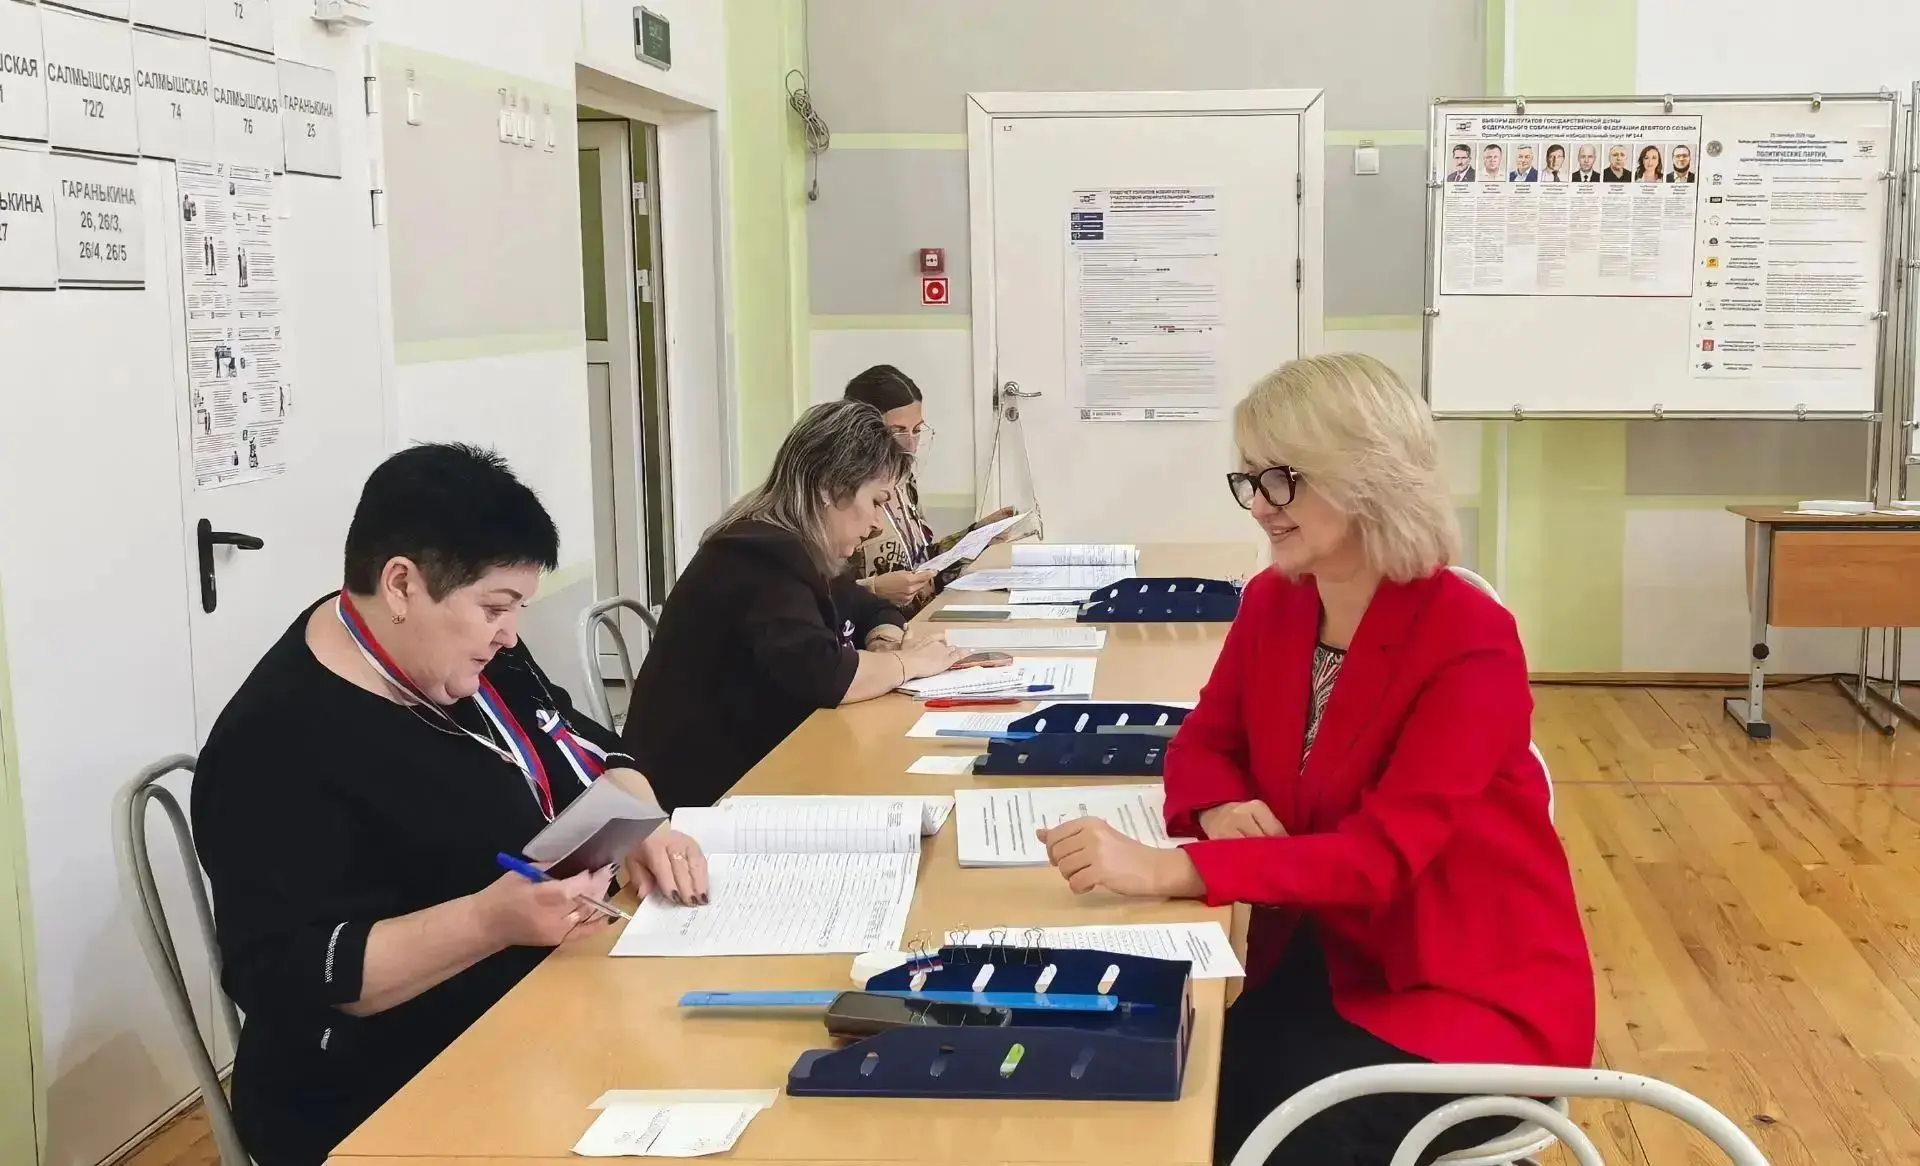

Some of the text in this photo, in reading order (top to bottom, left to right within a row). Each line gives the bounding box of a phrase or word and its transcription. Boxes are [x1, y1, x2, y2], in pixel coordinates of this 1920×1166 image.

[233, 2, 244, 19] 72
[0, 52, 38, 78] СКАЯ
[48, 63, 131, 95] САЛМЫШСКАЯ
[136, 70, 209, 96] САЛМЫШСКАЯ
[82, 98, 104, 118] 72/2
[170, 102, 182, 119] 74
[213, 87, 279, 114] САЛМЫШСКАЯ
[284, 94, 334, 118] ГАРАНЬКИНА
[243, 118, 253, 134] 76
[306, 122, 316, 138] 25
[61, 179, 137, 205] ГАРАНЬКИНА
[80, 210, 97, 232] 26,
[79, 241, 127, 262] 26/4, 26/5
